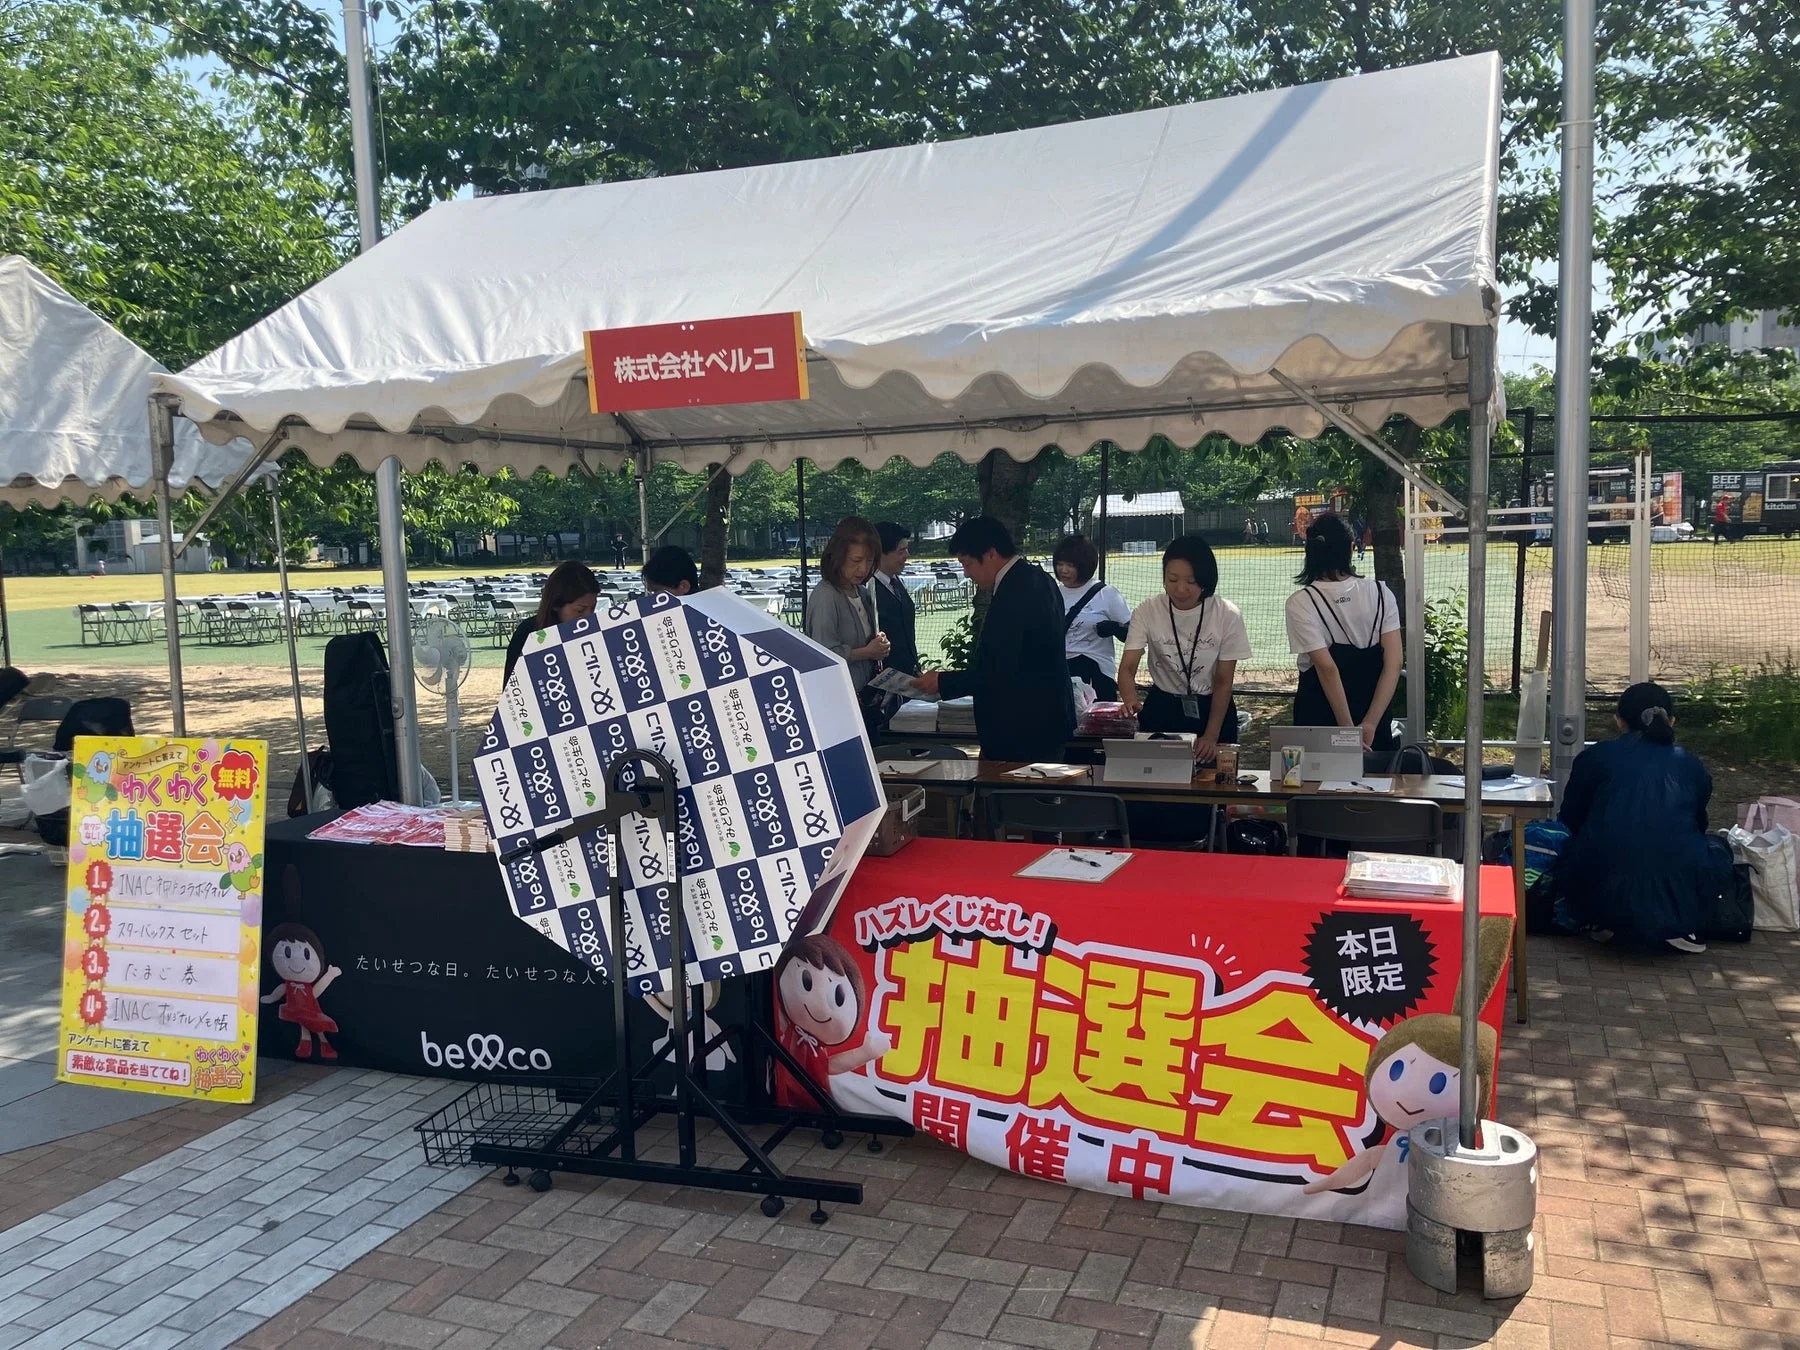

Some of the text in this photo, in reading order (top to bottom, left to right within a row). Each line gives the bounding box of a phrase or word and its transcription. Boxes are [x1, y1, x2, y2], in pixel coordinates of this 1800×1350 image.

[613, 347, 775, 384] 株式会社ベルコ
[1712, 475, 1741, 484] BEEF
[1764, 502, 1797, 510] kitchen
[662, 616, 686, 670] みどり生命
[580, 641, 601, 688] ベルコ
[728, 688, 752, 743] みどり生命
[122, 751, 182, 769] アンケートに答えて
[568, 735, 591, 788] みどり生命
[121, 771, 208, 807] わくわく
[218, 767, 251, 790] 無料
[490, 758, 510, 803] ベルコ
[794, 761, 815, 810] ベルコ
[712, 784, 735, 838] みどり生命
[105, 807, 225, 864] 抽選会
[119, 873, 153, 897] INAC
[776, 857, 797, 906] ベルコ
[696, 878, 718, 931] みどり生命
[856, 897, 1048, 946] ハズレくじなし!
[118, 921, 209, 945] スターバックス セット
[1336, 927, 1400, 962] 本日
[125, 963, 199, 986] たまご 券
[355, 953, 609, 986] たいせつな日。 たいせつな人。
[1341, 960, 1407, 998] 限定
[113, 997, 152, 1022] INAC
[67, 1033, 150, 1053] アンケートに答えて
[194, 1045, 240, 1067] わくわく
[876, 938, 1374, 1170] 抽選会
[71, 1054, 187, 1082] 素敵な賞品を当ててね!
[194, 1064, 244, 1092] 抽選会
[912, 1092, 1174, 1201] 開催中
